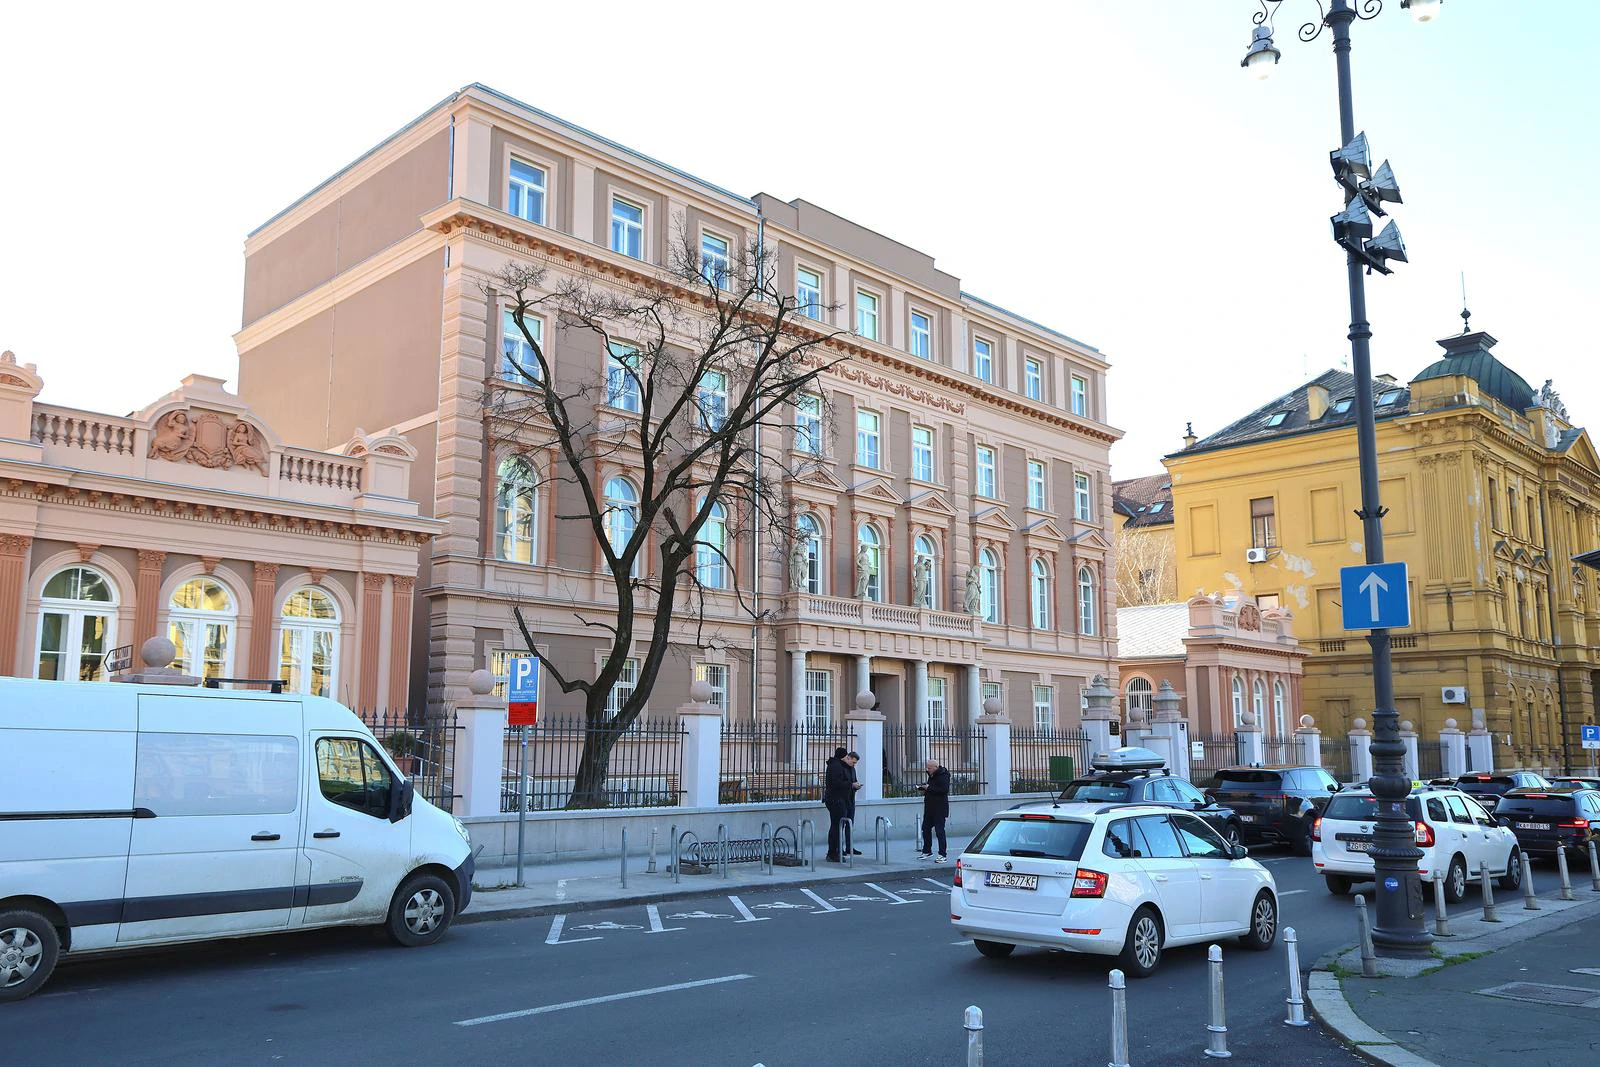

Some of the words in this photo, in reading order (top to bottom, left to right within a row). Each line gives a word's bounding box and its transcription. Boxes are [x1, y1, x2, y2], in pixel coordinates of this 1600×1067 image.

[516, 658, 532, 690] P
[1586, 728, 1595, 738] P
[1351, 842, 1359, 850] ZG
[990, 873, 1001, 884] ZG
